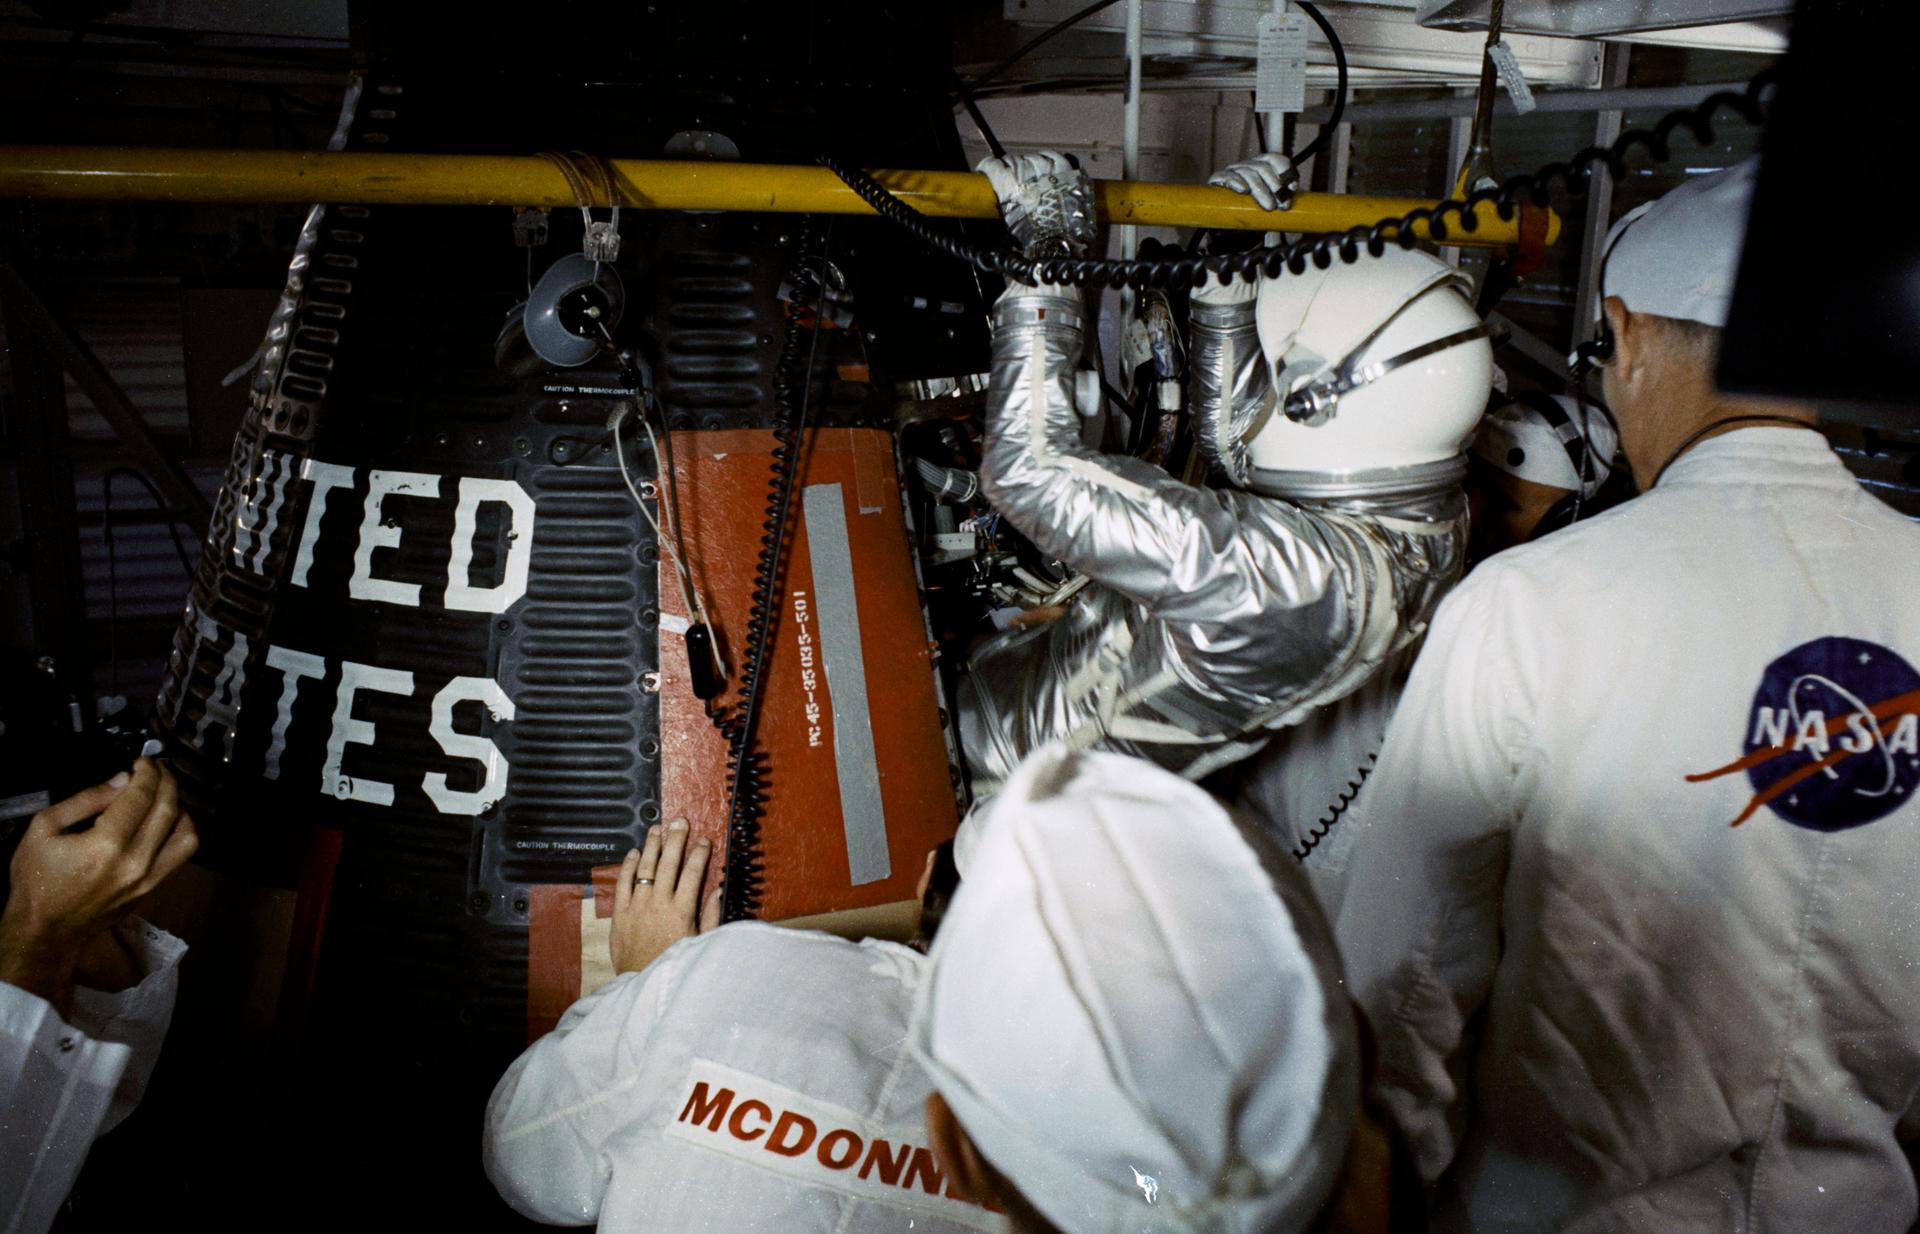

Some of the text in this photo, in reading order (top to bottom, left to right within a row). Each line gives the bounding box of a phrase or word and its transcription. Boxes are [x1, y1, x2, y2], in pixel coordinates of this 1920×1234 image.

[543, 385, 635, 395] CAUTION THERMOCOUPLE
[1751, 705, 1920, 755] NASA
[516, 841, 616, 851] CAUTION THERMOCOUPLE
[678, 1081, 1007, 1214] MCDONN
